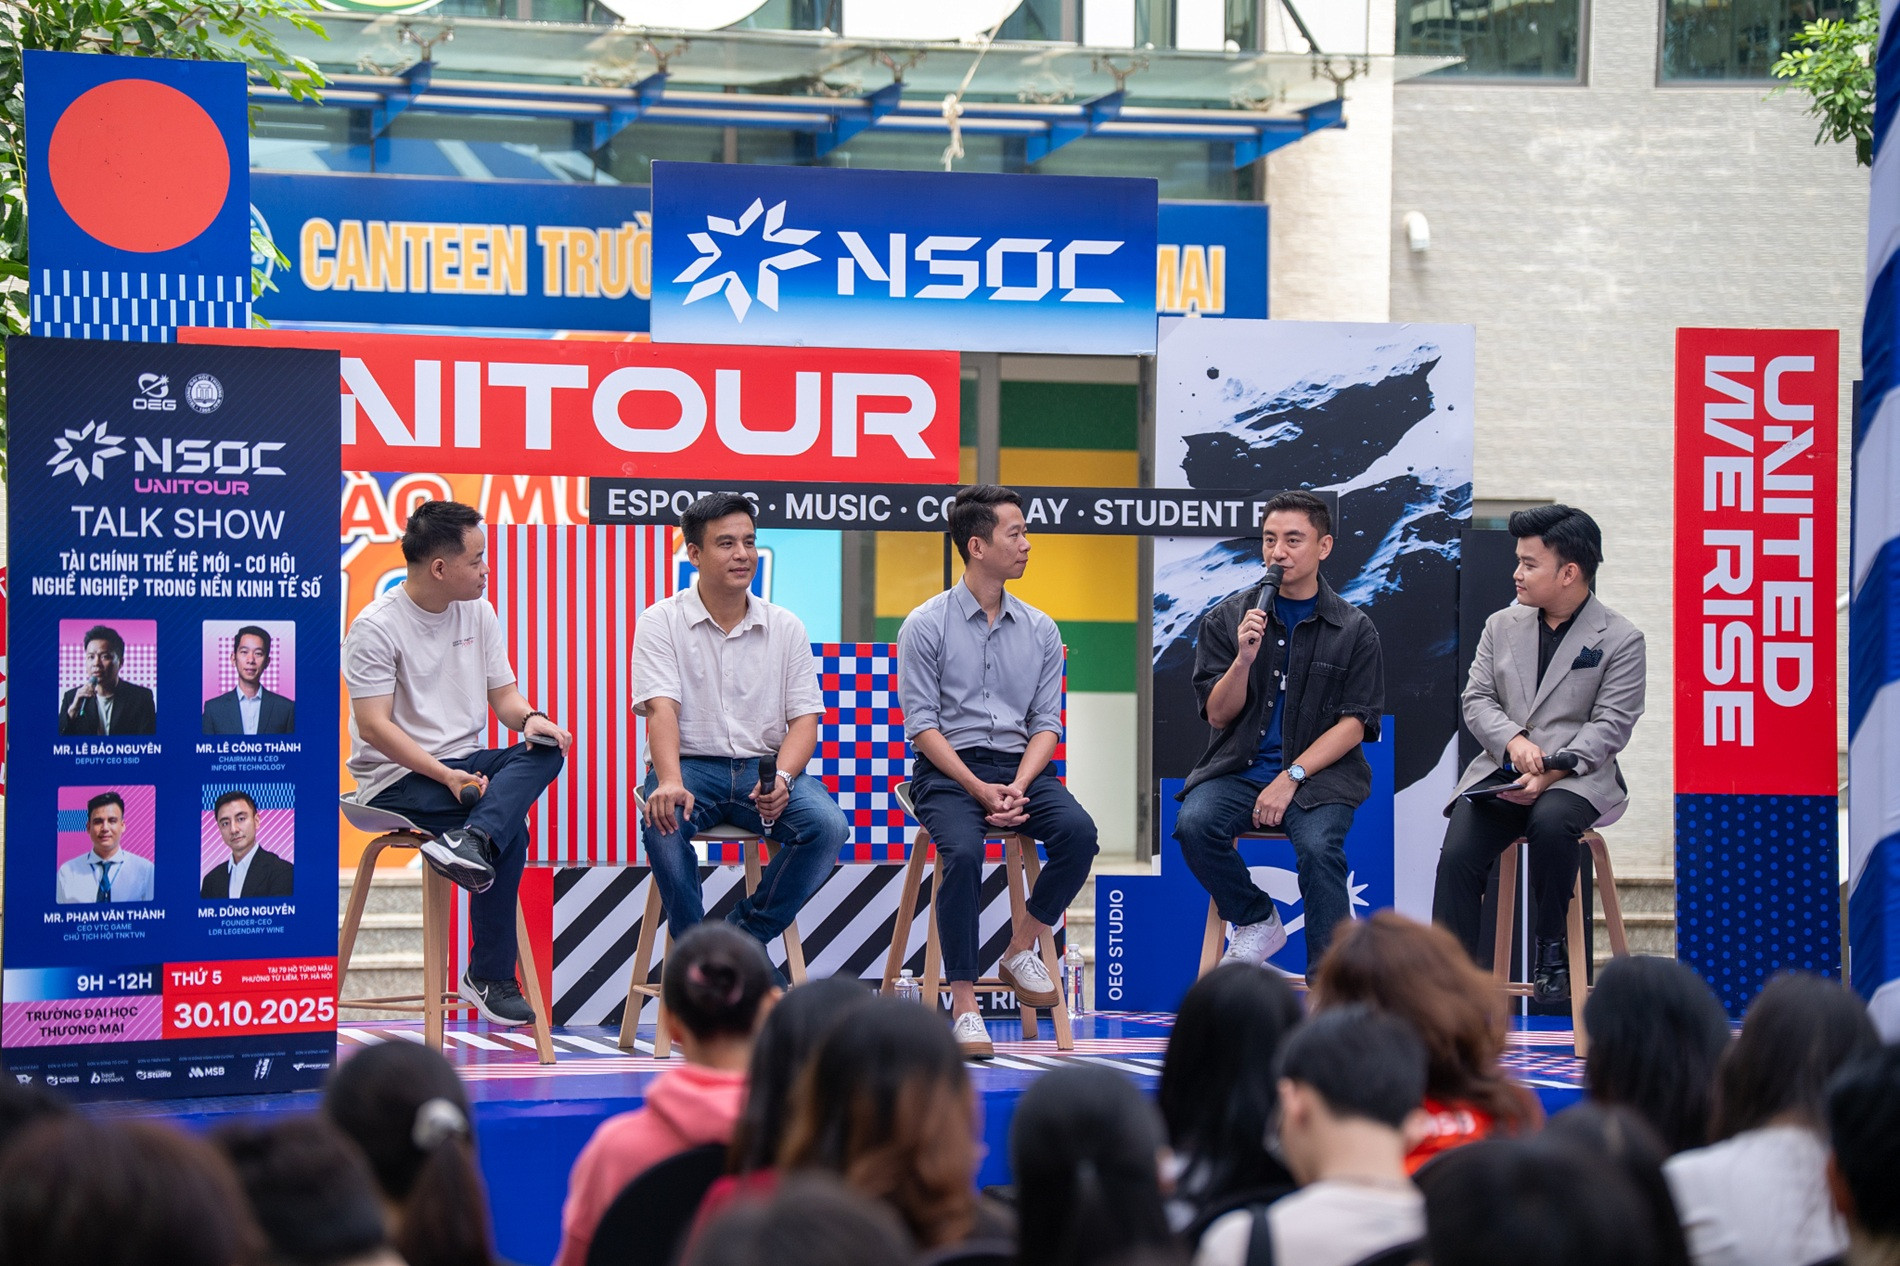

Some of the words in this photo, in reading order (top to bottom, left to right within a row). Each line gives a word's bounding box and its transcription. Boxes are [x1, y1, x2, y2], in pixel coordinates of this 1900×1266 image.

[300, 217, 527, 296] CANTEEN
[838, 231, 1124, 303] NSOC
[133, 398, 177, 411] OEG
[341, 357, 937, 459] NITOUR
[1703, 354, 1756, 512] WE
[134, 437, 287, 475] NSOC
[134, 478, 249, 495] UNITOUR
[608, 488, 760, 517] ESPOS
[786, 493, 891, 521] MUSIC
[1094, 498, 1243, 527] STUDENT
[71, 506, 163, 538] TALK
[174, 508, 285, 540] SHOW
[1763, 354, 1815, 708] UNITED
[59, 548, 85, 571] TÀI
[89, 549, 139, 572] CHÍNH
[143, 548, 177, 572] THẾ
[178, 550, 198, 578] HỆ
[202, 551, 230, 573] MỚI
[245, 554, 266, 573] CƠ
[270, 552, 295, 579] HỘI
[32, 571, 76, 596] NGHỀ
[80, 574, 139, 601] NGHIỆP
[143, 578, 196, 597] TRONG
[200, 573, 232, 597] NỀN
[237, 580, 273, 598] KINH
[278, 575, 299, 598] TẾ
[301, 575, 322, 598] SỐ
[1703, 529, 1755, 748] RISE
[53, 745, 73, 755] MR.
[75, 742, 88, 755] LÊ
[90, 741, 114, 755] BẢO
[195, 743, 215, 753] MR.
[217, 741, 229, 753] LÊ
[231, 741, 262, 753] CÔNG
[264, 740, 301, 753] THÀNH
[75, 757, 104, 765] DEPUTY
[106, 757, 122, 765] CEO
[218, 755, 256, 763] CHAIRMAN
[238, 763, 286, 771] TECHNOLOGY
[43, 912, 64, 923] MR.
[66, 910, 99, 924] PHẠM
[101, 908, 124, 921] VĂN
[127, 907, 165, 920] THÀNH
[198, 908, 217, 918] MR.
[219, 905, 250, 917] DŨNG
[77, 924, 93, 932] CEO
[110, 923, 132, 931] GAME
[208, 928, 223, 936] LDR
[223, 927, 265, 935] LEGENDARY
[266, 926, 285, 934] WINE
[221, 918, 273, 927] FOUNDER-CEO
[1109, 889, 1124, 958] STUDIO
[115, 931, 146, 939] TNKTVN
[77, 974, 104, 991] 9H
[171, 967, 208, 987] THỨ
[211, 970, 222, 985] 5
[1108, 962, 1123, 1001] OEG
[26, 1007, 81, 1022] TRƯỜNG
[84, 1008, 107, 1021] ĐẠI
[109, 1006, 139, 1020] HỌC
[173, 997, 335, 1029] 30.10.2025
[40, 1024, 97, 1037] THƯƠNG
[99, 1023, 125, 1036] MẠI
[205, 1067, 225, 1076] MSB
